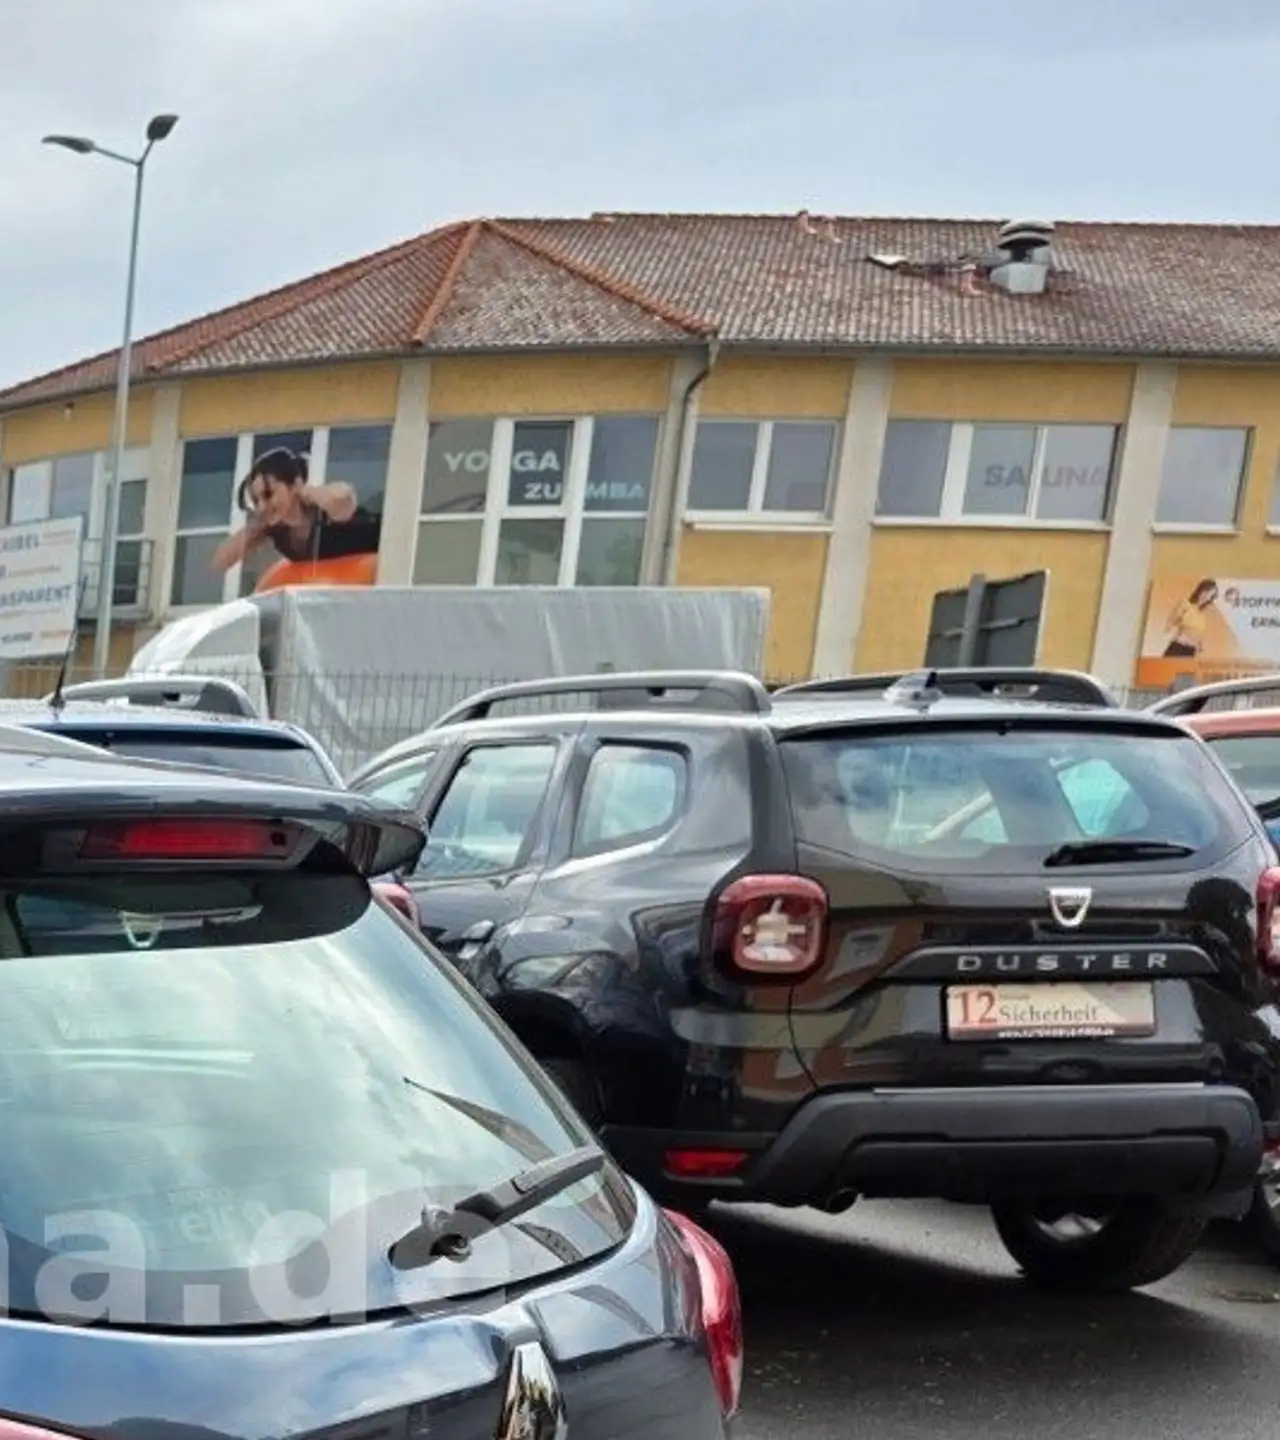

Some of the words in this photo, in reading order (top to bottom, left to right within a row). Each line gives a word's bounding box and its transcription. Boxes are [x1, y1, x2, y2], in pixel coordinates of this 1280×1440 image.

[984, 464, 1108, 488] SAUNA
[523, 481, 646, 500] ZUMBA
[957, 954, 1167, 971] DUSTER
[955, 990, 998, 1024] 12
[998, 1002, 1099, 1023] Sicherheit
